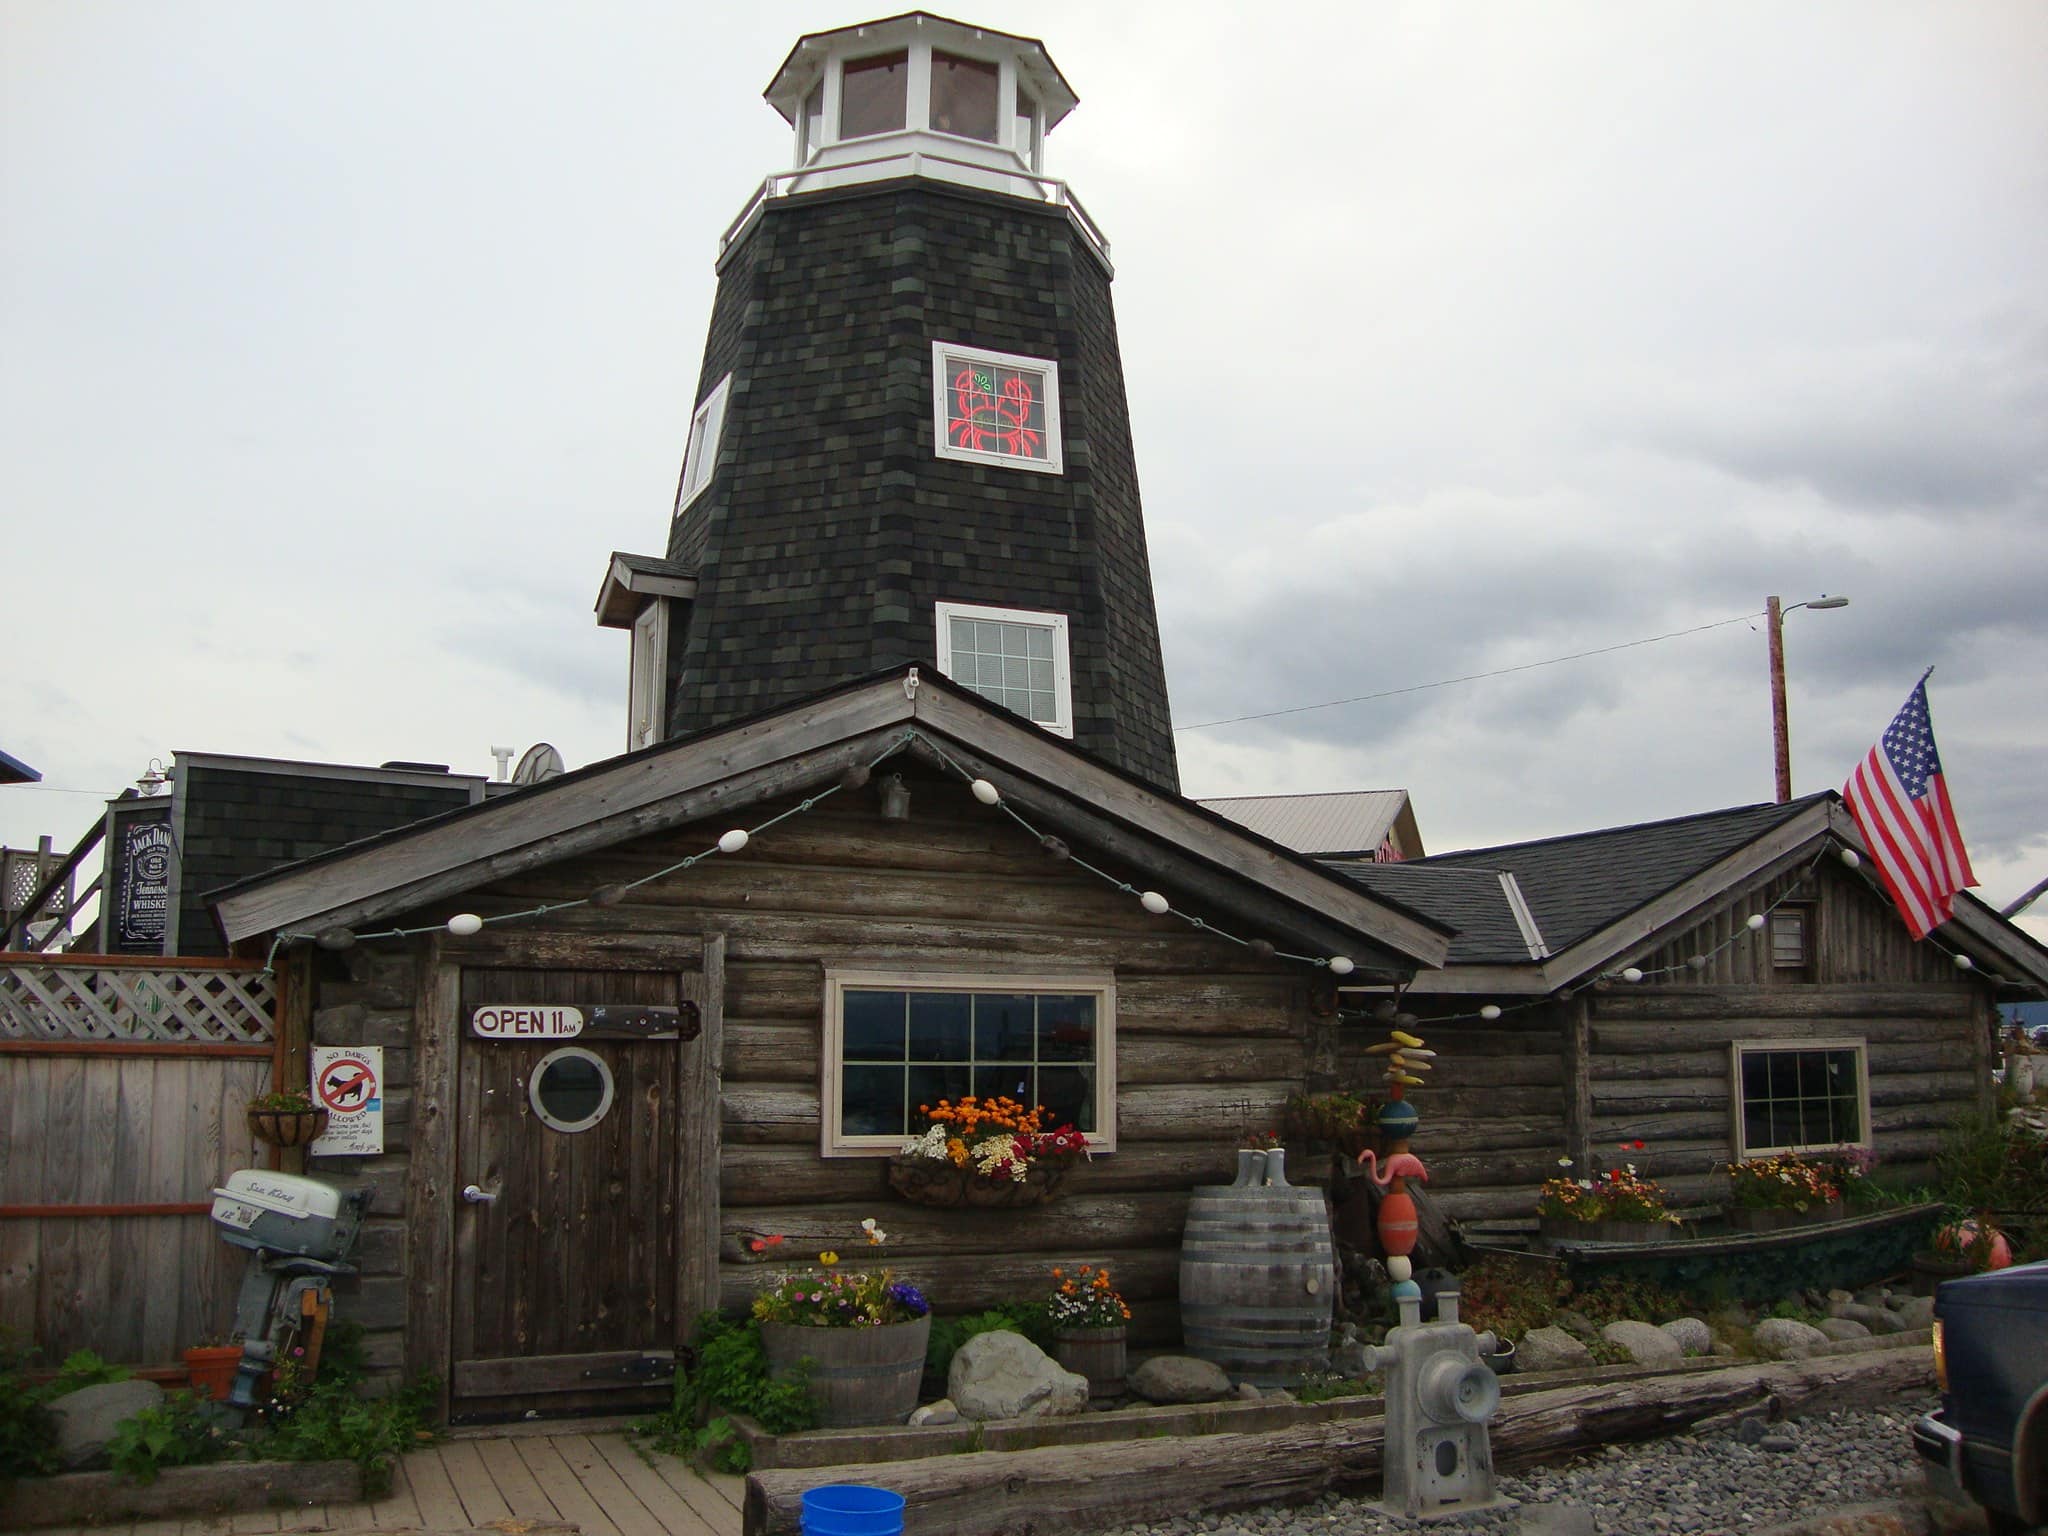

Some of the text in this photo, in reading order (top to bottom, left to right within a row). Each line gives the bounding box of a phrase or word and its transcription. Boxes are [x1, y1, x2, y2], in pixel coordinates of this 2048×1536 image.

[133, 833, 153, 857] JACK
[478, 1009, 544, 1034] OPEN
[326, 1050, 371, 1065] NO DAWGS
[328, 1110, 367, 1123] ALLOWED
[246, 1182, 295, 1203] Sea King
